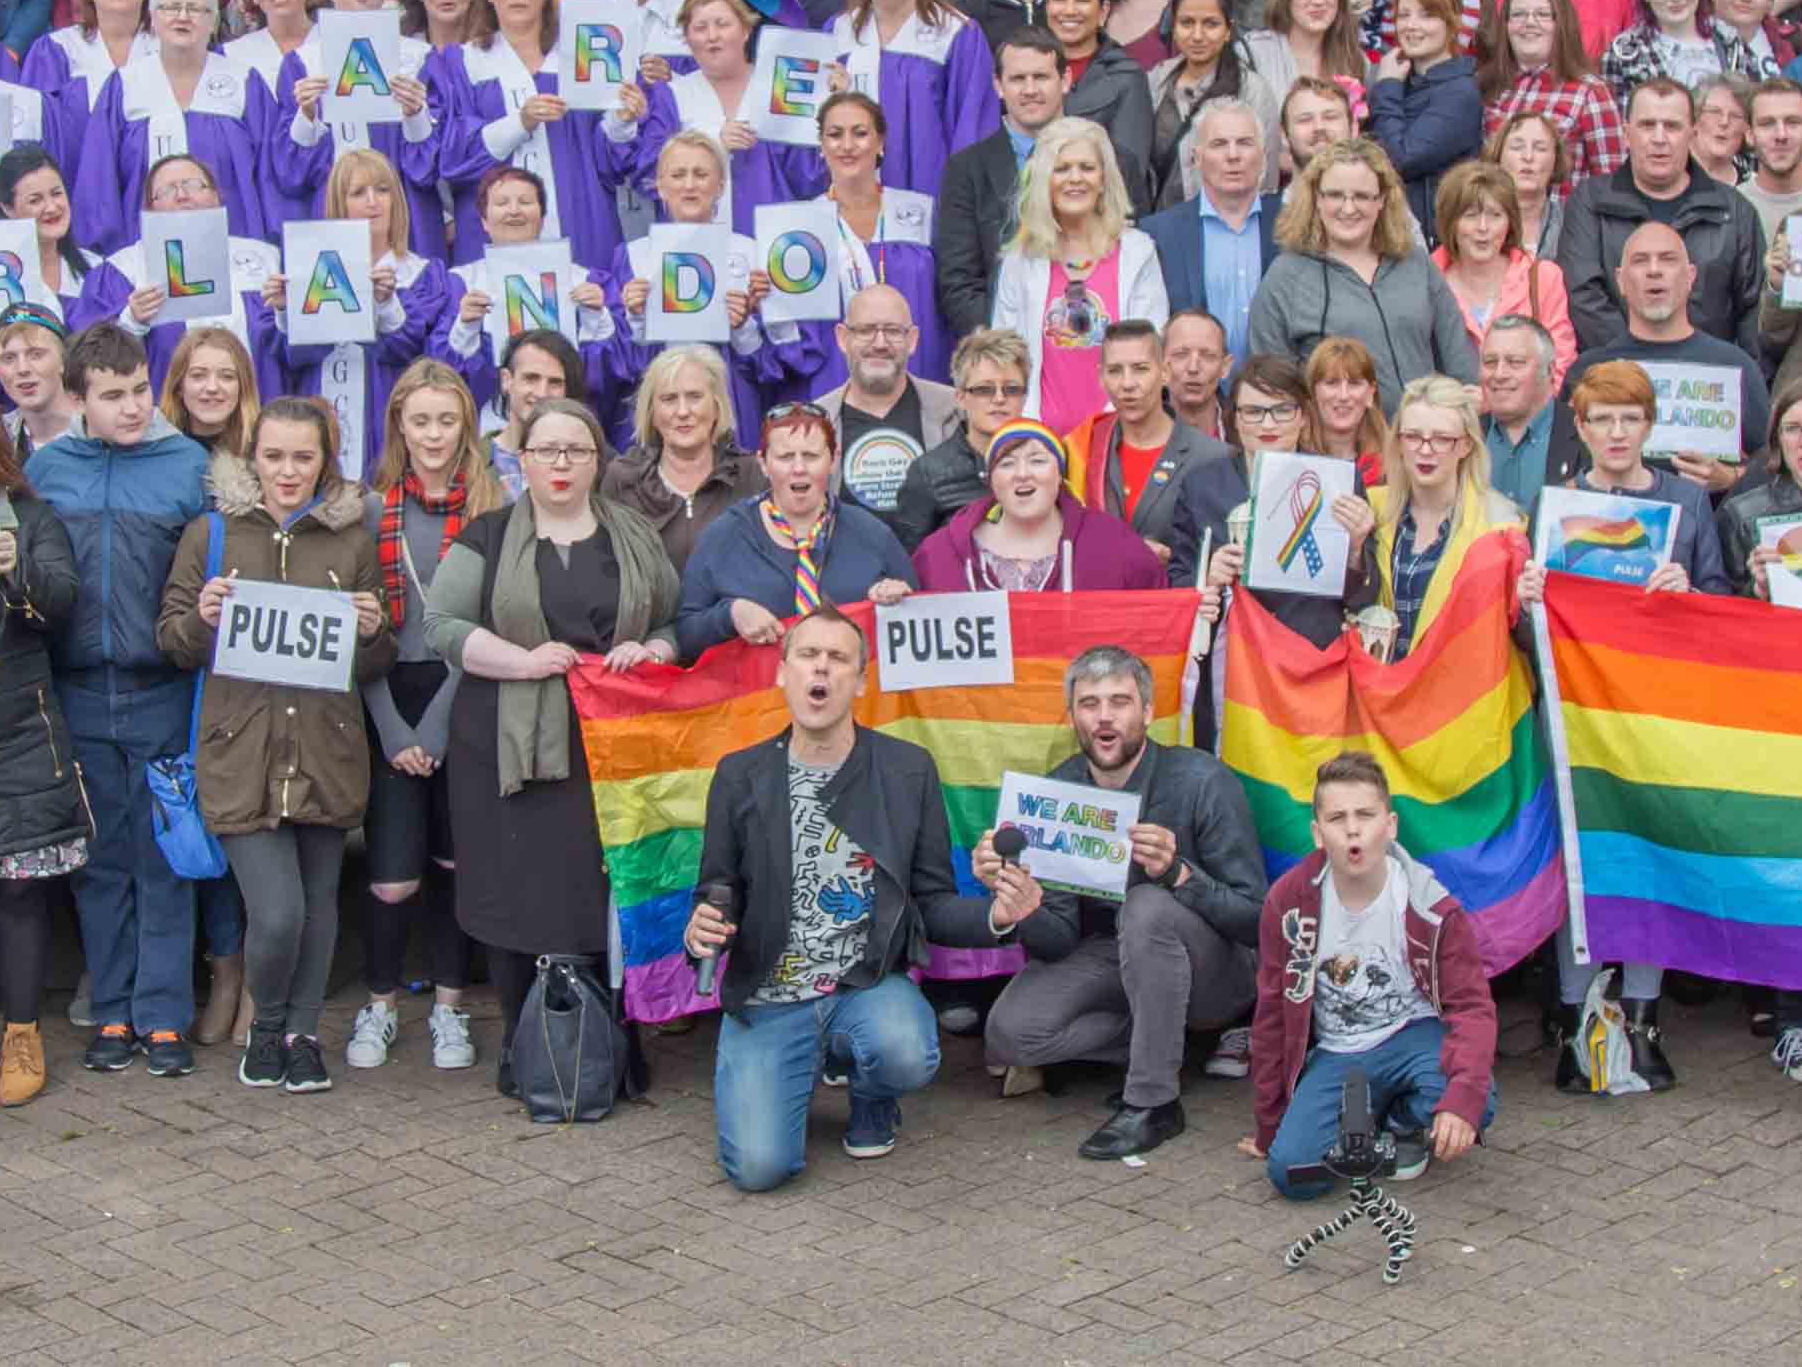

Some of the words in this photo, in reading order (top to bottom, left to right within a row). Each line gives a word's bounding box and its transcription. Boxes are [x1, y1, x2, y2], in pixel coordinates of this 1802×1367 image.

[1675, 379, 1725, 402] ARE
[227, 603, 343, 662] PULSE
[886, 616, 998, 665] PULSE
[1017, 791, 1058, 821] WE
[1062, 801, 1118, 833] ARE
